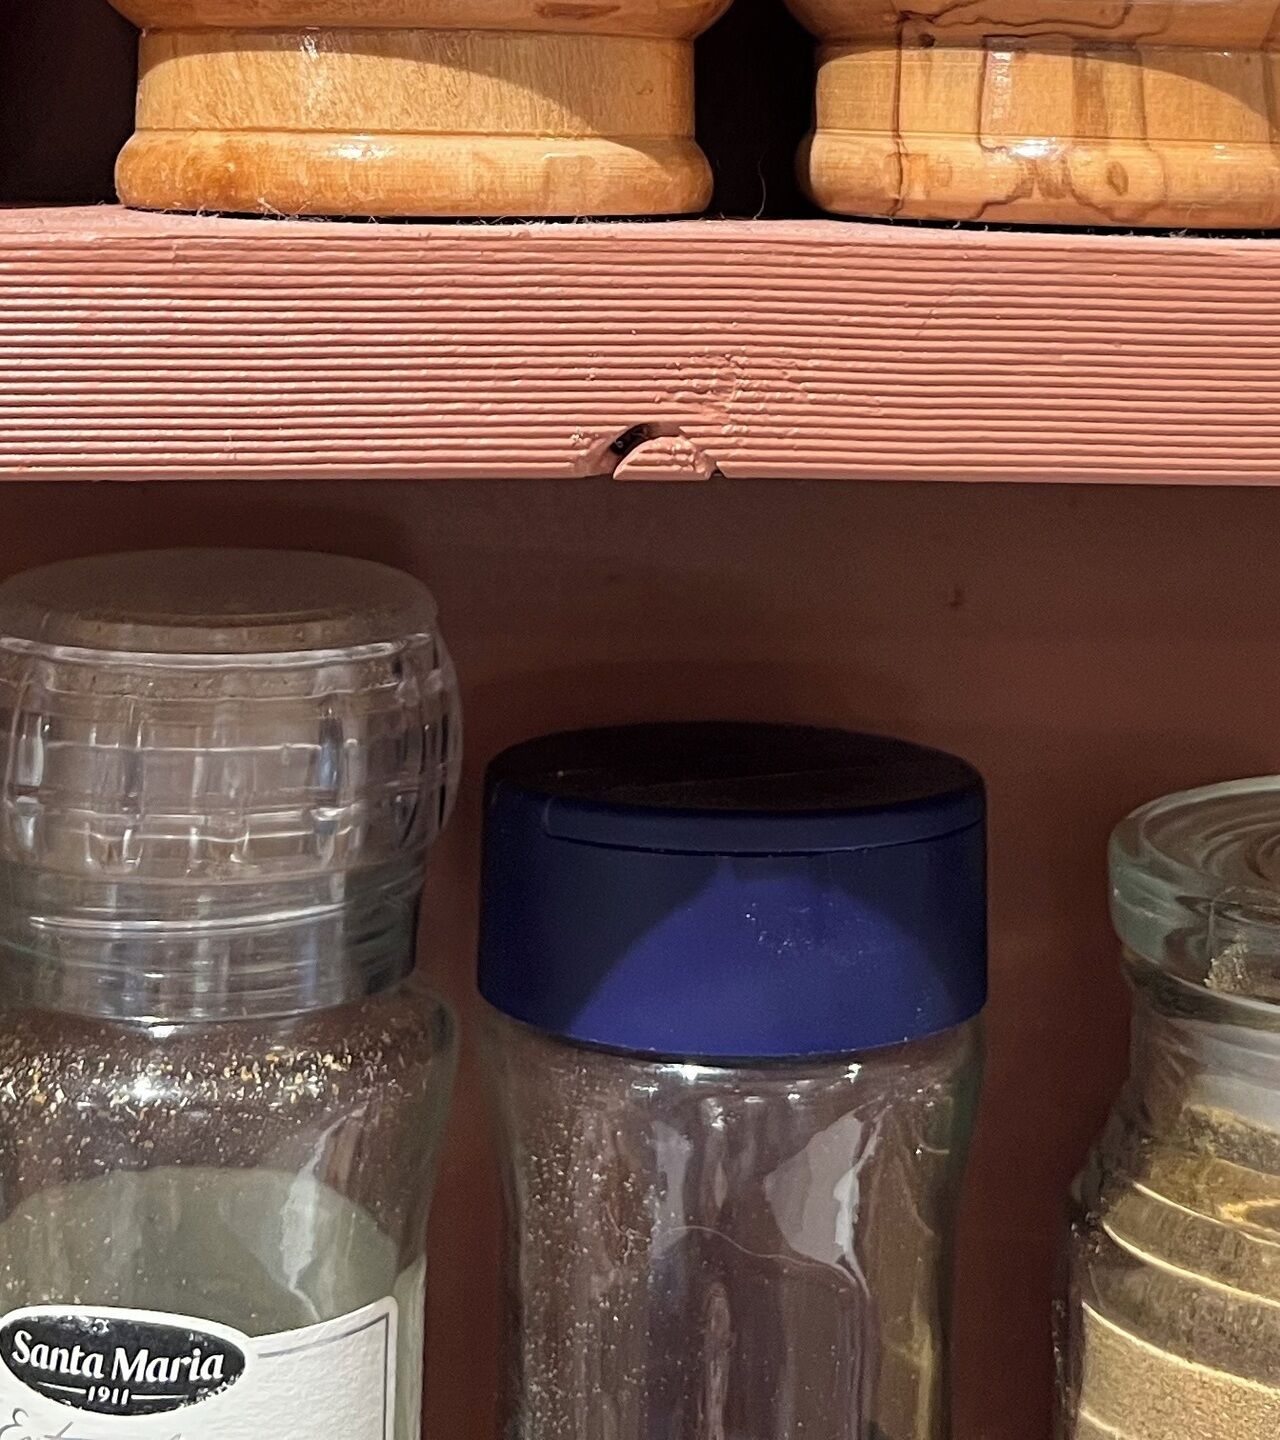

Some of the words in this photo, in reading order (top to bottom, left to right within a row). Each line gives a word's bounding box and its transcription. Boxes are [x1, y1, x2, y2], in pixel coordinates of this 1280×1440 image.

[11, 1329, 105, 1380] Santa
[110, 1346, 225, 1383] Maria
[86, 1385, 131, 1406] 1911
